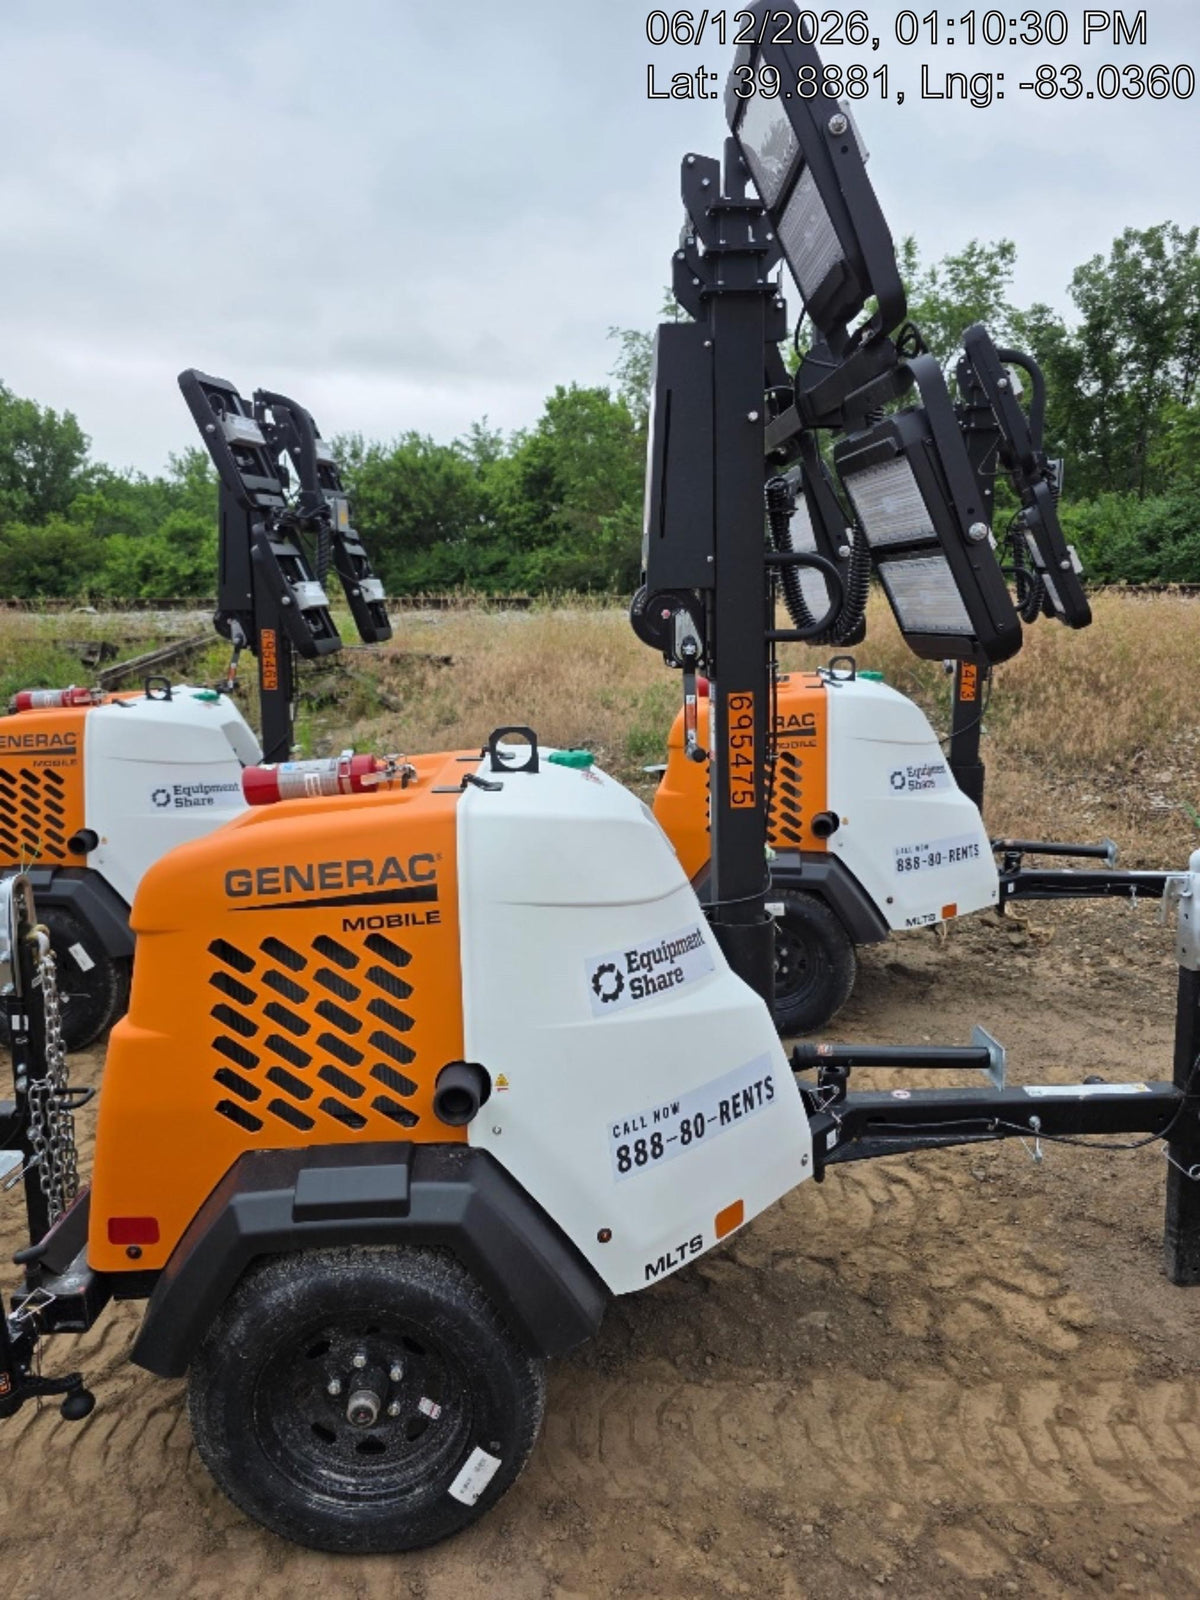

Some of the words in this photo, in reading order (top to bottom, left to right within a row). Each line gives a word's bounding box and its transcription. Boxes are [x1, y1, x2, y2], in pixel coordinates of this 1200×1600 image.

[729, 695, 754, 805] 695475
[173, 782, 240, 796] Equipment
[174, 797, 214, 808] Share
[224, 853, 437, 898] GENERAC
[342, 910, 441, 932] MOBILE
[625, 928, 706, 976] Equipment
[629, 966, 685, 1000] Share
[612, 1116, 648, 1139] CALL
[653, 1101, 681, 1124] NOW
[616, 1075, 775, 1174] 888-80-RENTS
[645, 1235, 704, 1281] MLTS
